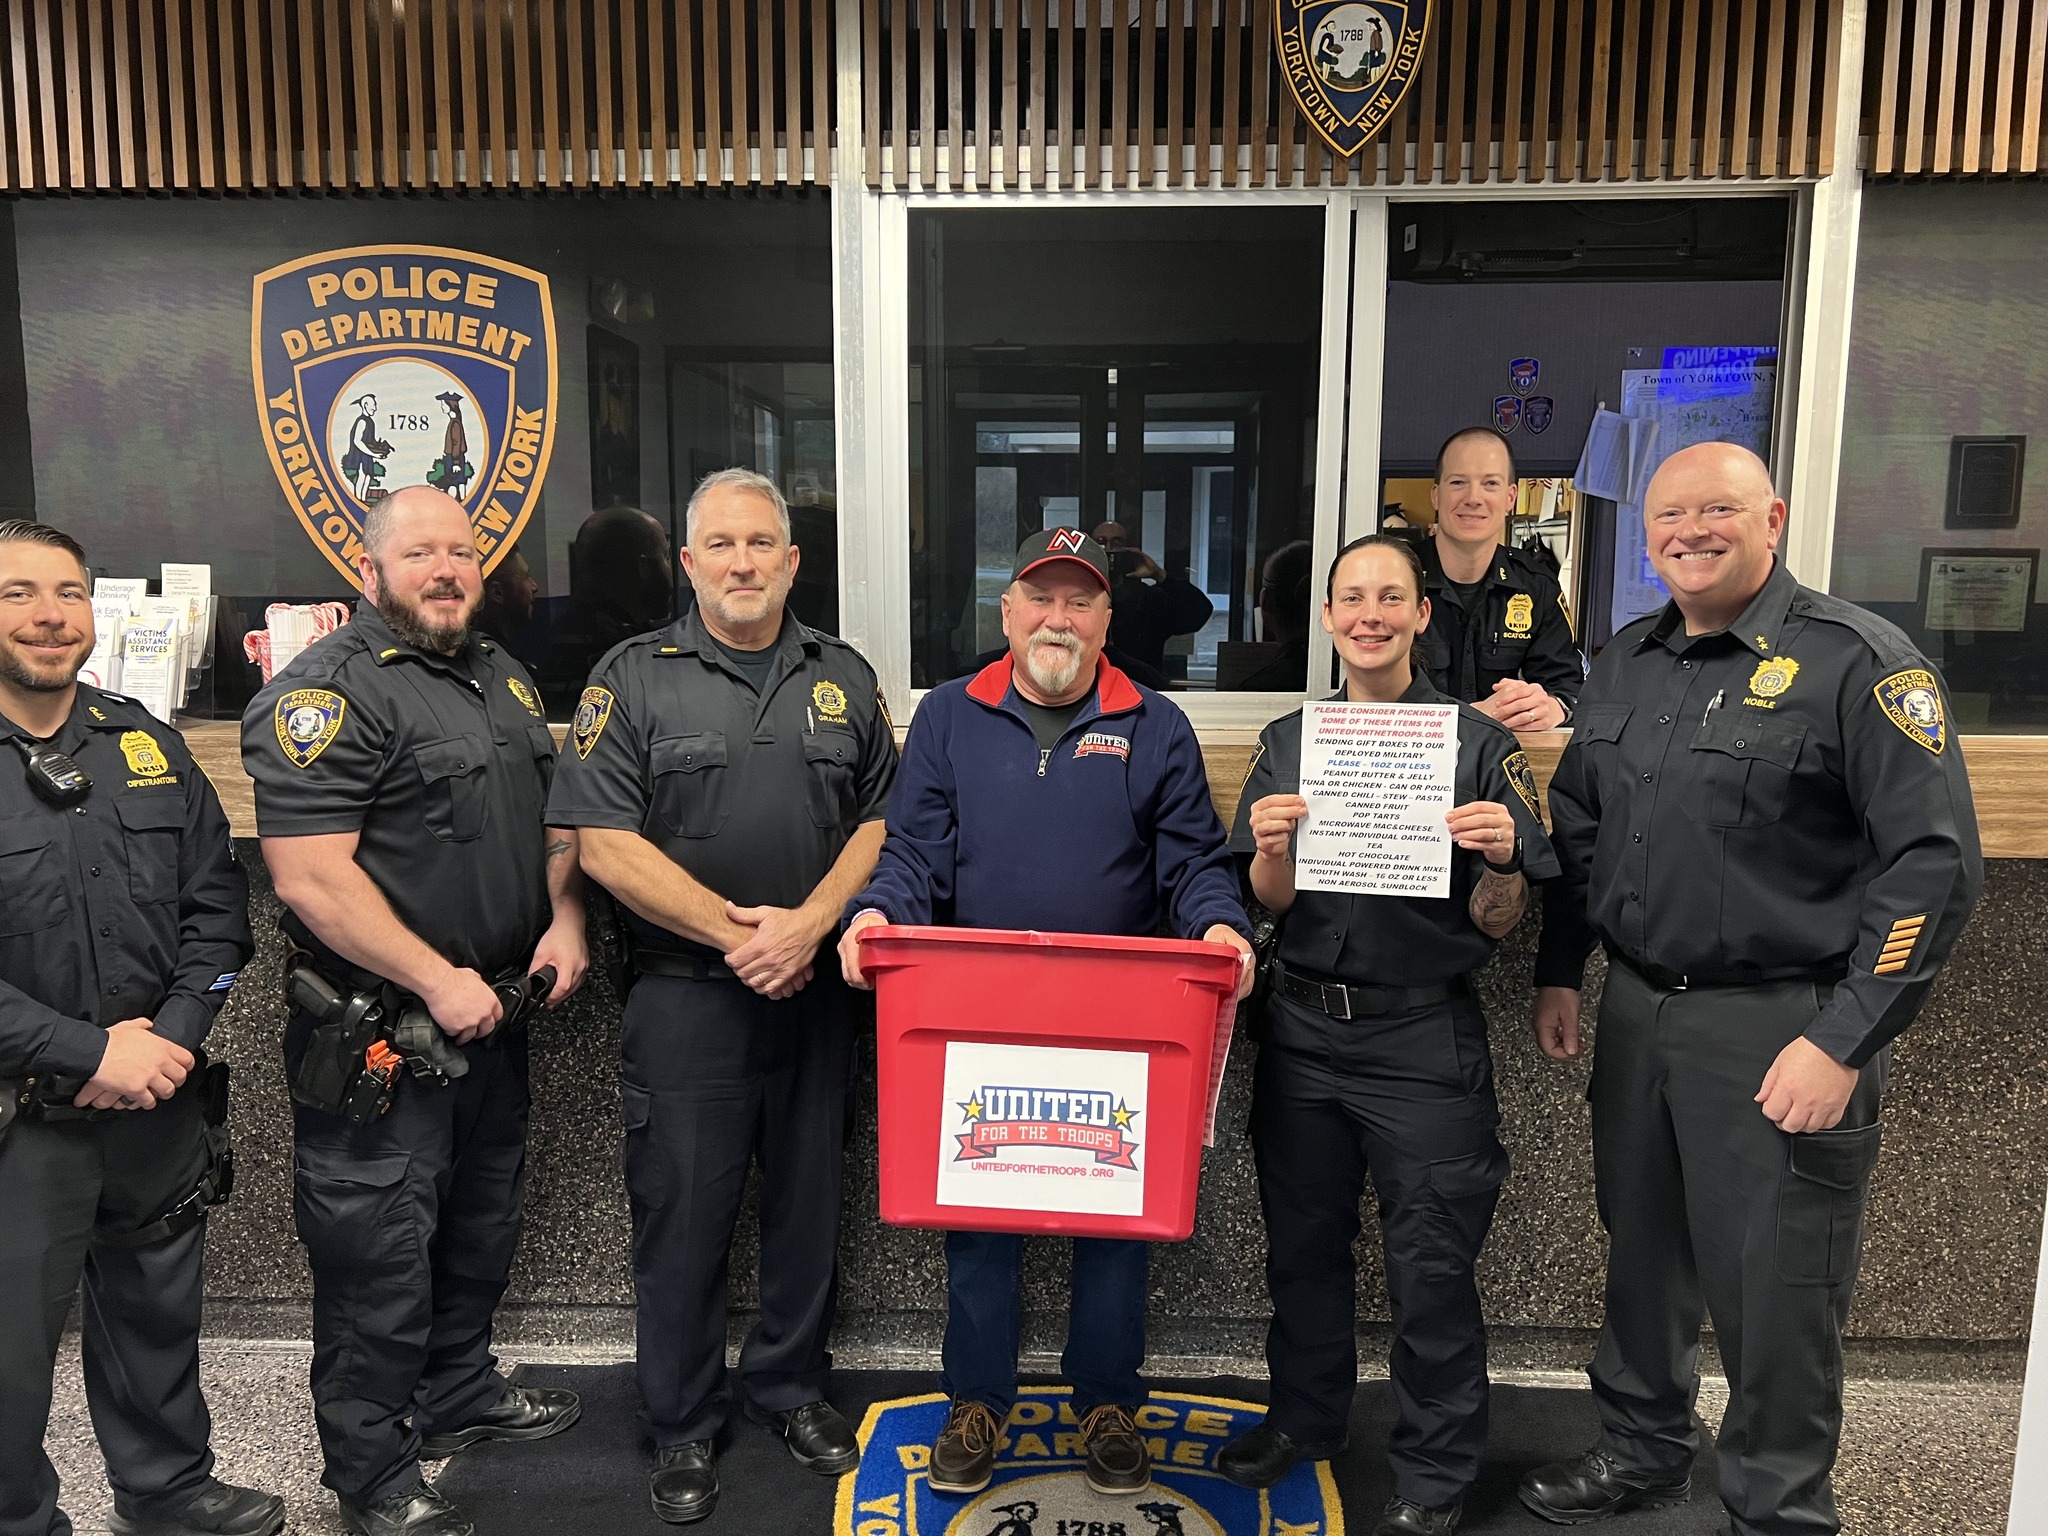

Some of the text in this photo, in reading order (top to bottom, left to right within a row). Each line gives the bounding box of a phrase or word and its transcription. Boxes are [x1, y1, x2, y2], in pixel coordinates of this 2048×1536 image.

[1340, 29, 1364, 42] 1788
[1283, 25, 1340, 134] YORKTOWN
[1356, 26, 1422, 134] NEW YORK
[307, 266, 499, 309] POLICE
[281, 308, 532, 362] DEPARTMENT
[1641, 375, 1672, 385] Town
[1675, 374, 1687, 384] of
[389, 414, 430, 431] 1788
[269, 388, 366, 570] YORKTOW
[473, 405, 544, 562] EW YORK
[101, 584, 136, 593] Underage
[134, 630, 168, 638] VICTIMS
[1503, 632, 1531, 640] SCATOLA
[130, 645, 168, 653] SERVICES
[1888, 673, 1929, 689] POLICE
[1885, 680, 1934, 699] DEPARTMENT
[291, 692, 333, 702] POLICE
[1742, 697, 1776, 709] NOBLE
[284, 699, 338, 711] DEPARTMENT
[1314, 706, 1348, 714] PLEASE
[1350, 707, 1396, 716] CONSIDER
[1397, 709, 1436, 717] PICKING
[818, 714, 848, 724] GRAHAM
[1321, 717, 1347, 725] SOME
[1363, 718, 1392, 726] THESE
[1888, 703, 1934, 746] YORKTOWN
[278, 714, 300, 760] YORKTOWN
[304, 718, 339, 759] NEW YORK
[1318, 728, 1444, 739] UNITEDFORTHETROOPS.ORG
[1085, 735, 1128, 751] UNITED
[1314, 738, 1354, 746] SENDING
[1356, 739, 1377, 747] GIFT
[1378, 740, 1408, 748] BOXES
[1411, 741, 1423, 749] TO
[1335, 749, 1425, 759] DEPLOYED MILITARY
[1327, 759, 1361, 768] PLEASE
[1323, 769, 1360, 777] PEANUT
[1361, 771, 1396, 779] BUTTER
[1407, 773, 1435, 781] JELLY
[1342, 781, 1383, 789] CHICKEN
[1424, 784, 1452, 792] POUC
[1312, 789, 1349, 797] CANNED
[1350, 791, 1375, 799] CHILI
[1415, 794, 1443, 802] PASTA
[1345, 801, 1410, 811] CANNED FRUIT
[1352, 811, 1401, 820] POP TARTS
[1318, 820, 1434, 832] MICROWAVE MAC&CHEESE
[1309, 829, 1442, 843] INSTANT INDIVIDUAL OATMEAL
[1358, 852, 1411, 861] CHOCOLATE
[1298, 858, 1347, 867] INDIVIDUAL
[1349, 861, 1391, 870] POWERED
[1308, 868, 1340, 876] MOUTH
[1341, 870, 1367, 878] WASH
[1338, 880, 1378, 889] AEROSOL
[1380, 882, 1429, 891] SUNBLOCK
[982, 1087, 1112, 1127] UNITED
[980, 1126, 1113, 1148] FOR THE TROOPS
[971, 1161, 1087, 1177] UNITEDFORTHETROOPS
